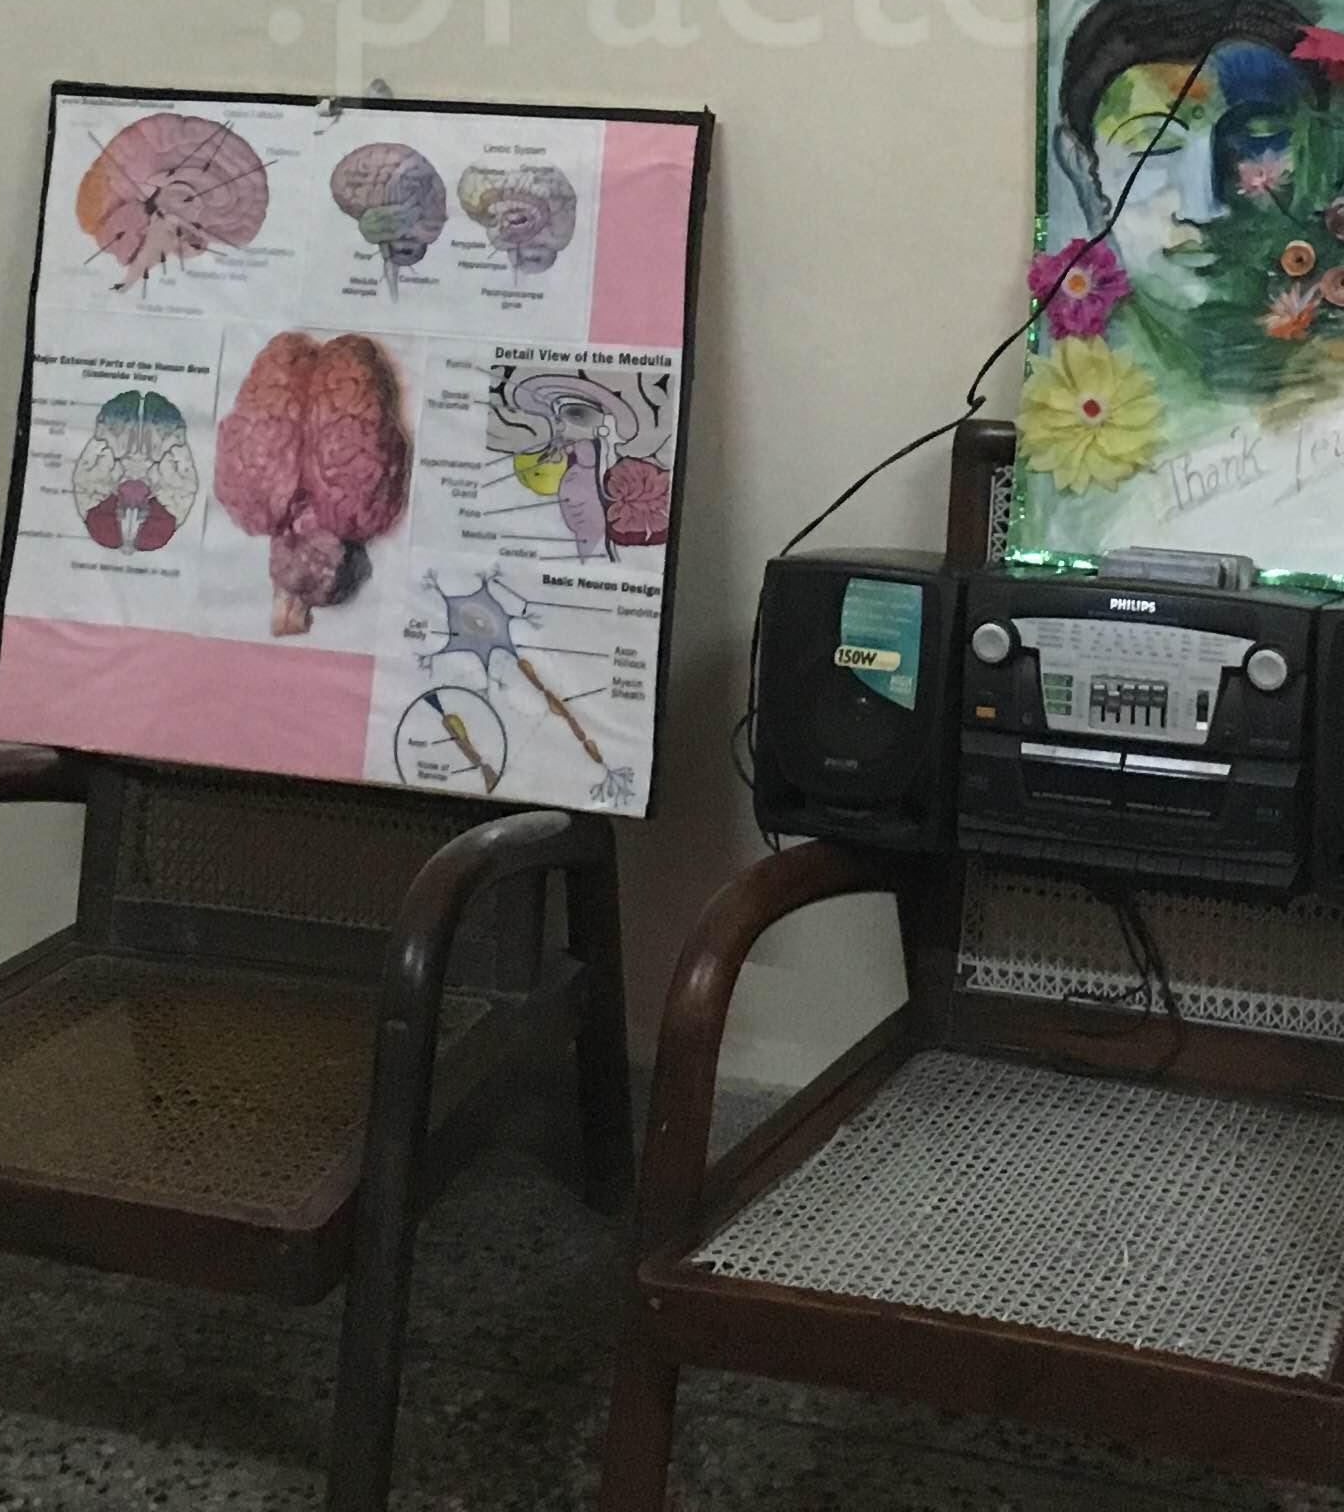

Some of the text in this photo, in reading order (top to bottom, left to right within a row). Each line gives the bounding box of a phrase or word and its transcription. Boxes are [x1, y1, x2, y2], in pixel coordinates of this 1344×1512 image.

[514, 145, 546, 157] System
[60, 356, 97, 366] External
[100, 358, 123, 368] Parts
[126, 361, 136, 369] of
[137, 361, 152, 370] the
[495, 346, 672, 367] Detail View of the Medulla
[1155, 434, 1268, 510] Thank
[542, 574, 660, 597] Basic Neuron Design
[1109, 598, 1156, 614] PHILIPS
[409, 618, 429, 629] Cell
[403, 629, 427, 641] Body
[614, 646, 638, 657] Axon
[838, 649, 878, 667] 150W
